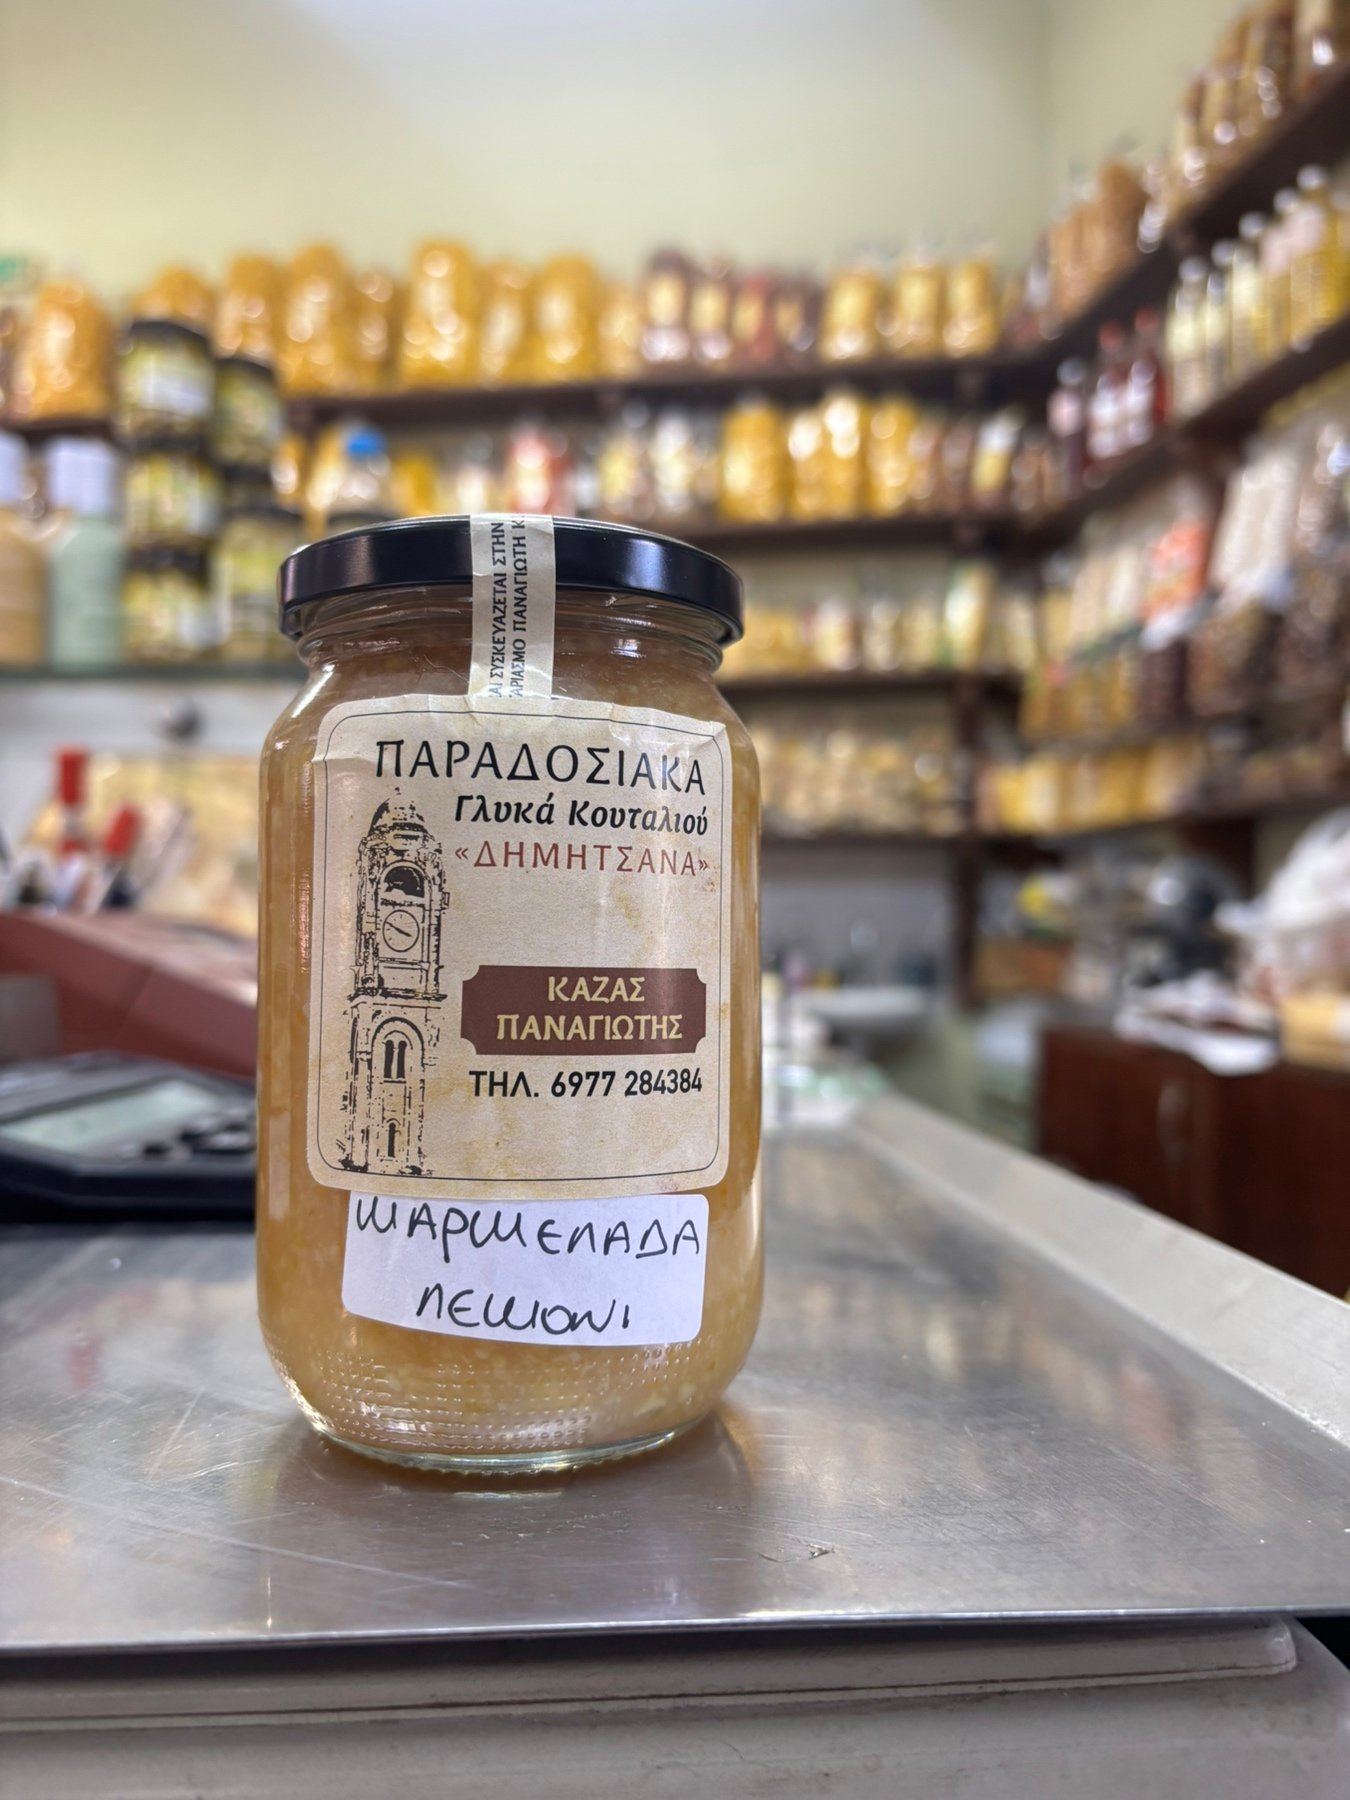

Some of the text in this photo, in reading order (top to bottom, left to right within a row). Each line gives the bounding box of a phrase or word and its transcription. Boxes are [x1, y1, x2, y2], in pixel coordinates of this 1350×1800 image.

[512, 535, 527, 632] ΠΑΝΑΓΙΩΤΗ
[488, 522, 507, 698] ΑΙ ΣΥΣΚΕΥΑΖΕΤΑΙ ΣΤΗΝ
[509, 638, 526, 698] ΑΡΙΑΣΜΟ
[375, 740, 706, 796] ΠΑΡΑΔΟΣΙΑΚΑ
[455, 792, 708, 836] Γλυκά Κουταλιού
[455, 841, 708, 876] «ΔΗΜΗΤΣΑΝΑ»
[547, 976, 646, 1003] ΚΑΖΑΣ
[496, 1014, 683, 1041] ΠΑΝΑΓΙΩΤΗΣ
[469, 1067, 703, 1097] ΤΗΛ. 6977 284384
